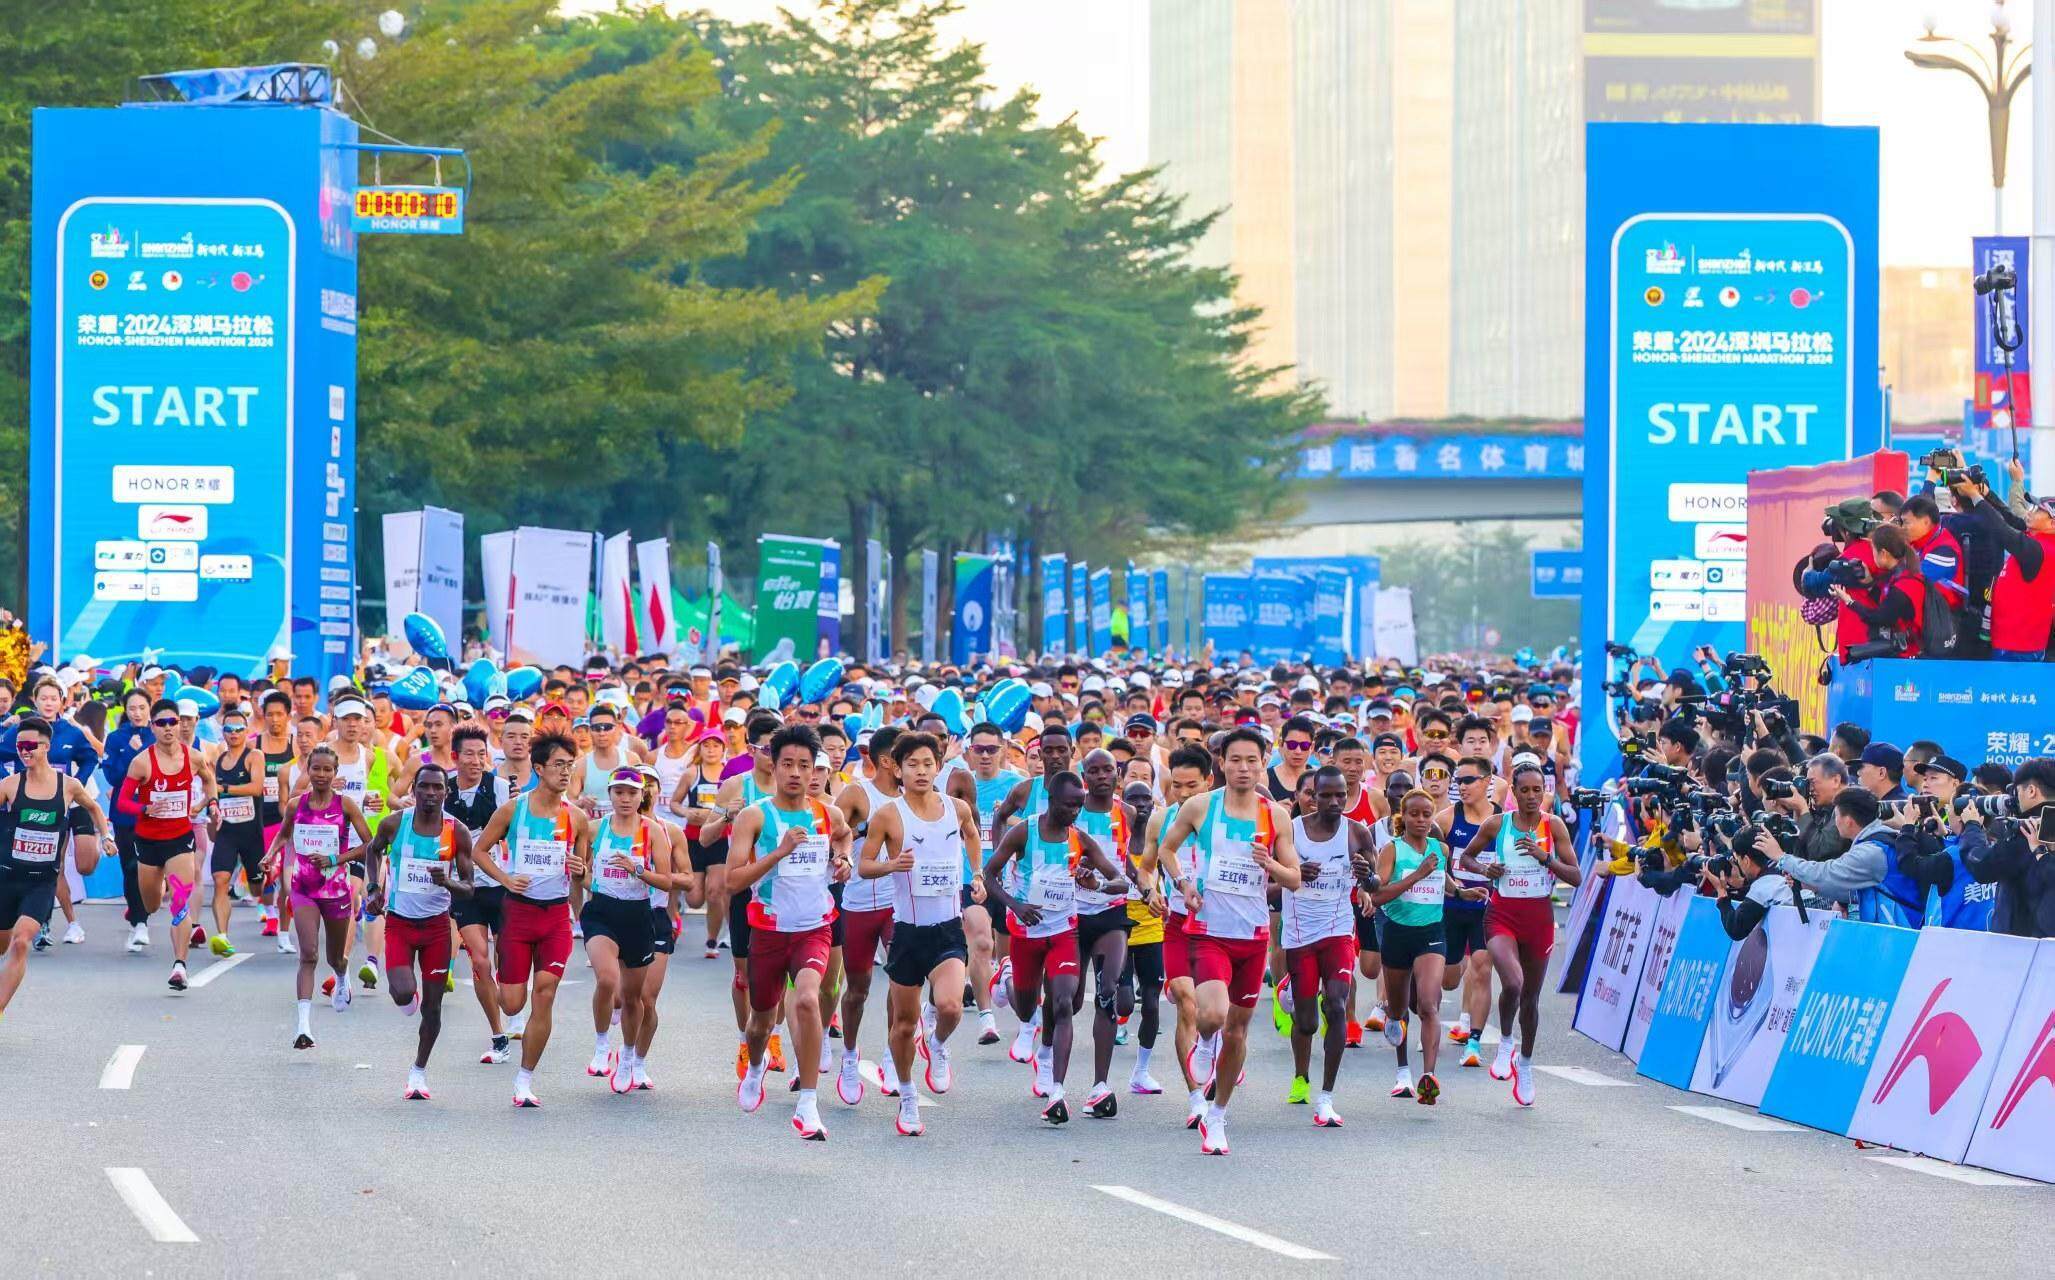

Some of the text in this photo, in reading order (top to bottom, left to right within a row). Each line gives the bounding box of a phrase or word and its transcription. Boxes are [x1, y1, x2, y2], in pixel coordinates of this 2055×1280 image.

[371, 219, 418, 229] HONOR
[185, 336, 246, 347] MARATHON
[248, 337, 274, 347] 2024
[1743, 352, 1805, 364] MARATHON
[1806, 353, 1833, 365] 2024
[92, 386, 259, 426] START
[1647, 403, 1818, 445] START
[128, 478, 189, 491] HONOR
[1685, 496, 1747, 509] HONOR
[403, 671, 431, 696] 3:00
[16, 840, 50, 854] A 12214
[303, 838, 322, 847] Nare
[922, 875, 949, 886] 王文杰
[1218, 870, 1248, 884] 王红伟
[1508, 878, 1529, 887] Dido
[1044, 890, 1064, 900] Kirui
[1660, 958, 1702, 1017] HONOR
[1790, 991, 1860, 1061] HONOR
